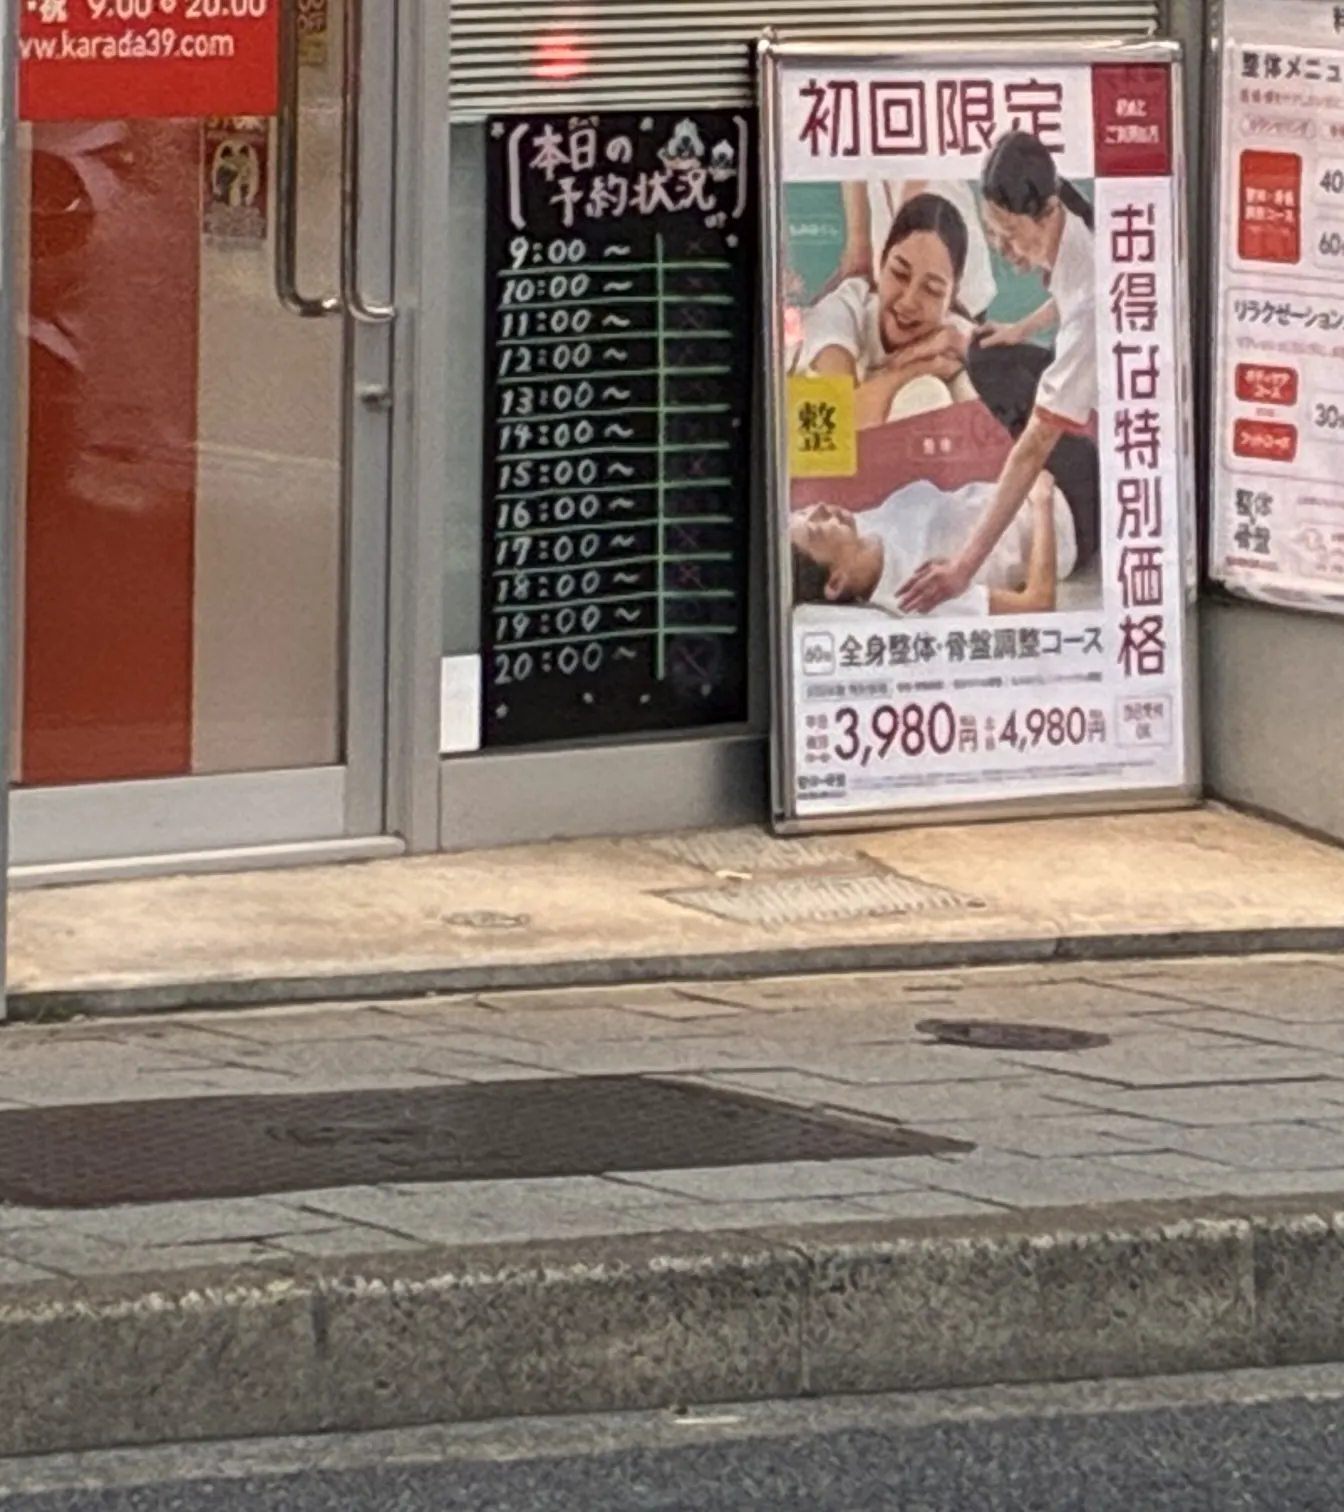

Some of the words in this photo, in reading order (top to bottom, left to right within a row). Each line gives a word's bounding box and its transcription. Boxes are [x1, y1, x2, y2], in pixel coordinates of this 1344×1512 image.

[798, 78, 1066, 157] 初回限定
[529, 123, 633, 182] 本日の
[548, 169, 717, 228] 予約状況
[1110, 203, 1166, 678] お得な特別価格
